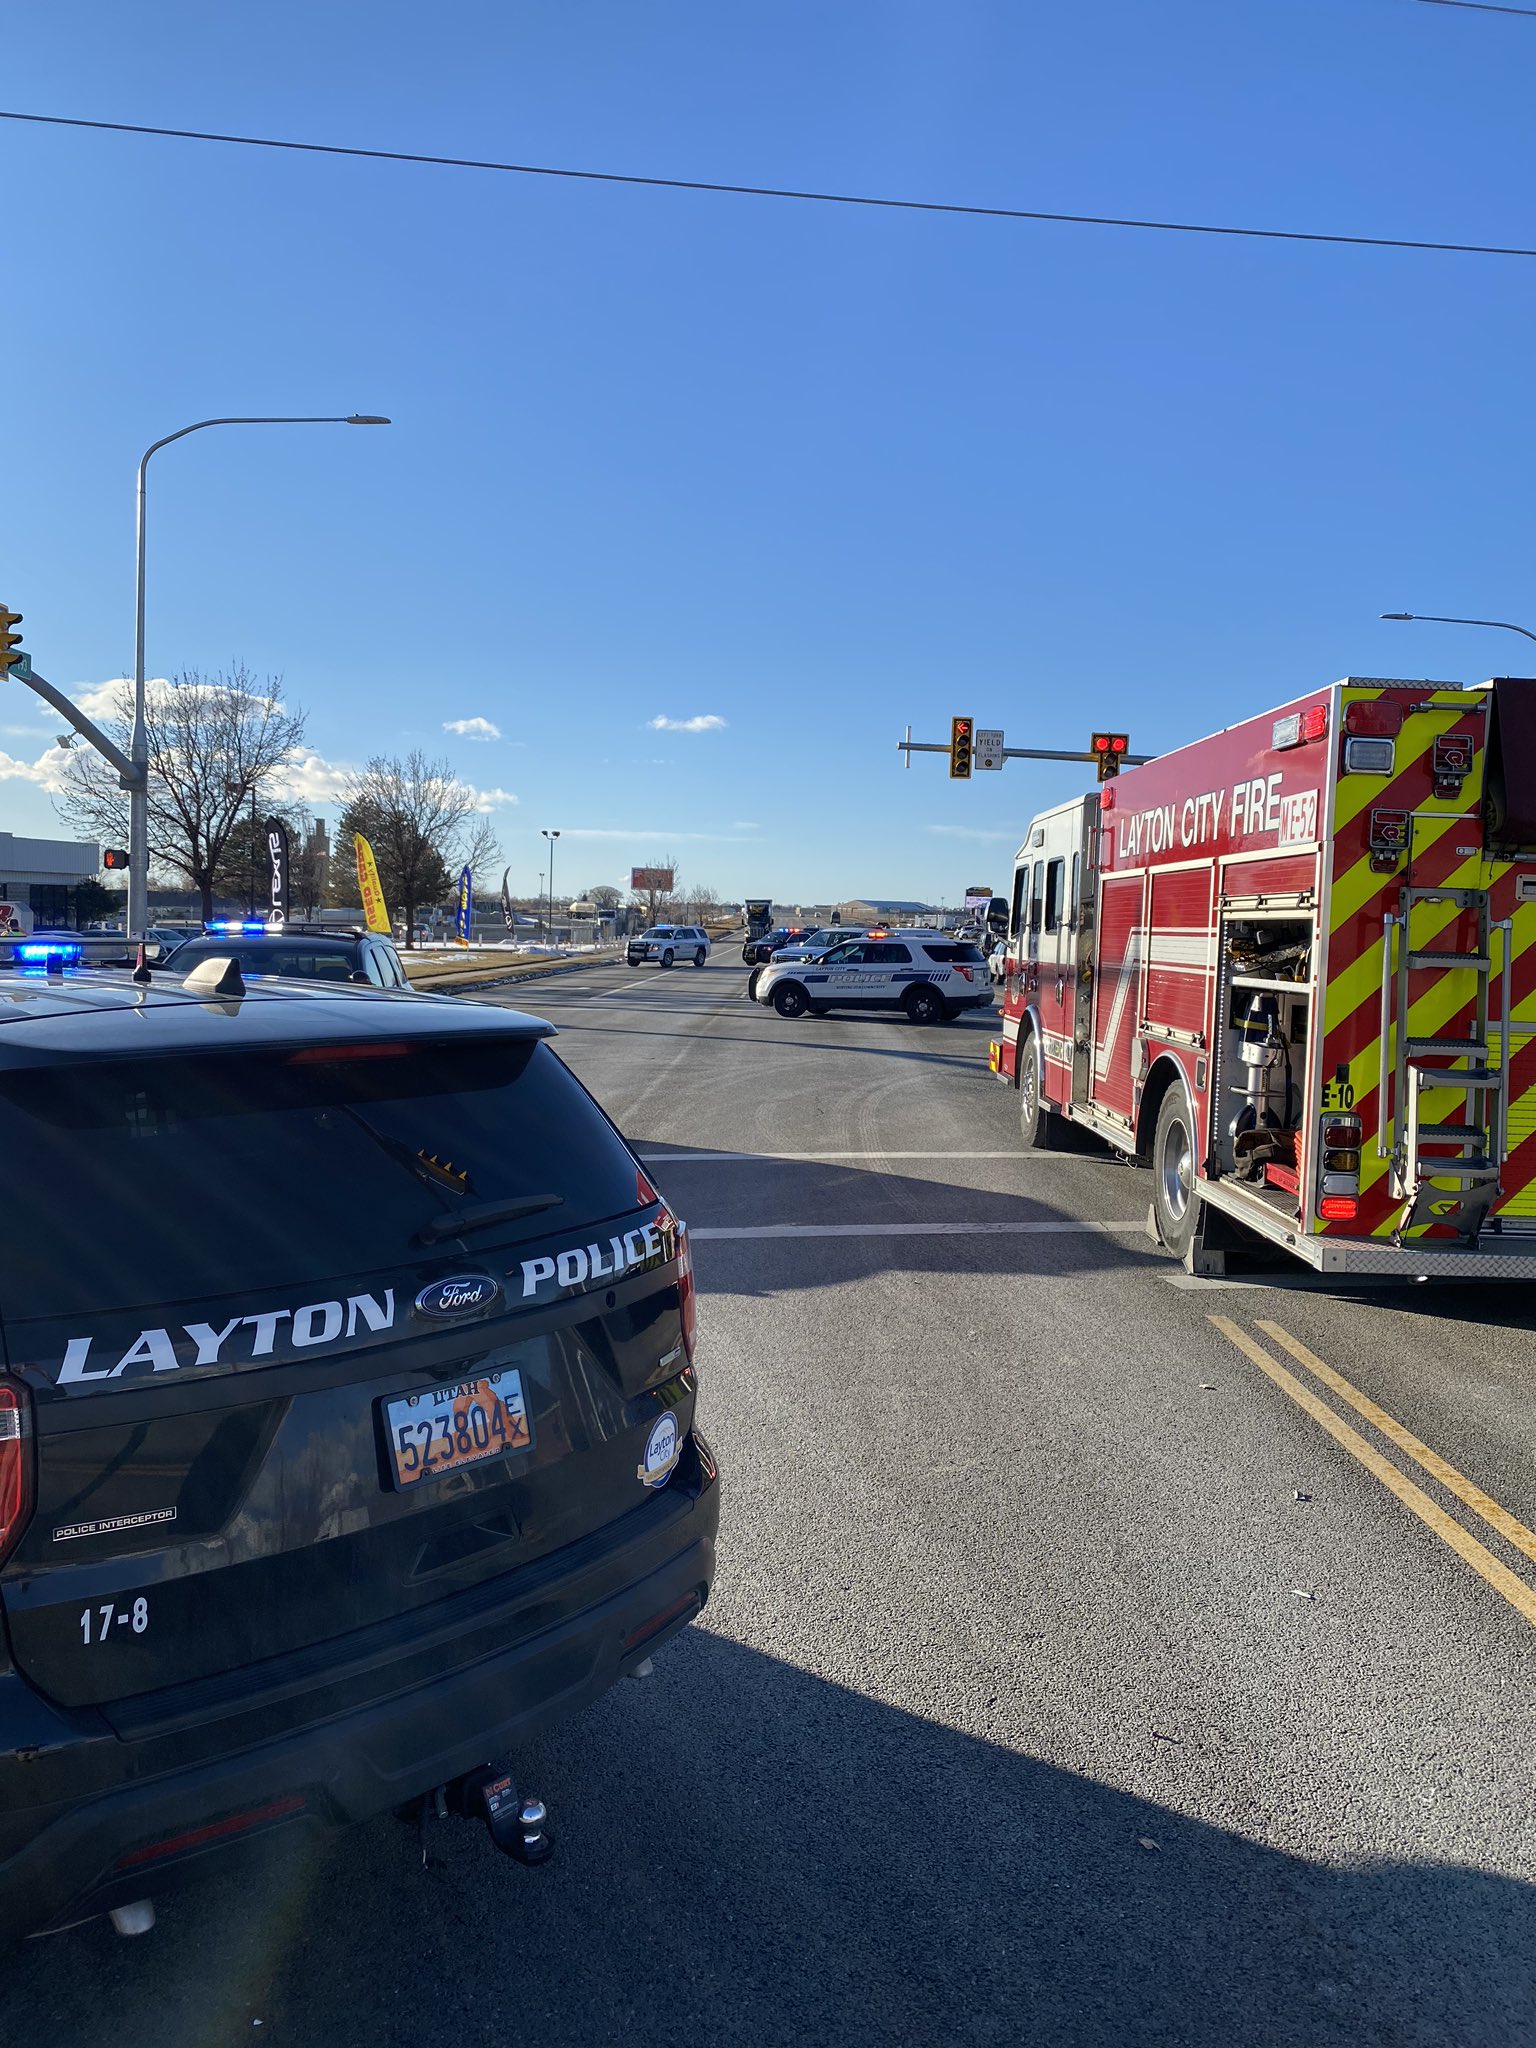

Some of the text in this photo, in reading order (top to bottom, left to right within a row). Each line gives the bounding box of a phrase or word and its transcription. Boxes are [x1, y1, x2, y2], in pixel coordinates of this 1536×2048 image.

[1119, 772, 1283, 858] LAYTON CITY FIRE
[828, 973, 892, 983] POLICE
[1321, 1083, 1354, 1109] E-10
[520, 1222, 662, 1297] POLICE
[439, 1281, 483, 1310] Ford
[56, 1288, 395, 1384] LAYTON
[432, 1380, 480, 1406] UTAH
[399, 1400, 506, 1471] 523804
[649, 1432, 675, 1458] Layton
[432, 1447, 501, 1474] LIFE ELEVATED
[56, 1510, 173, 1538] POLICE INTERCEPTOR
[81, 1597, 148, 1645] 17-8
